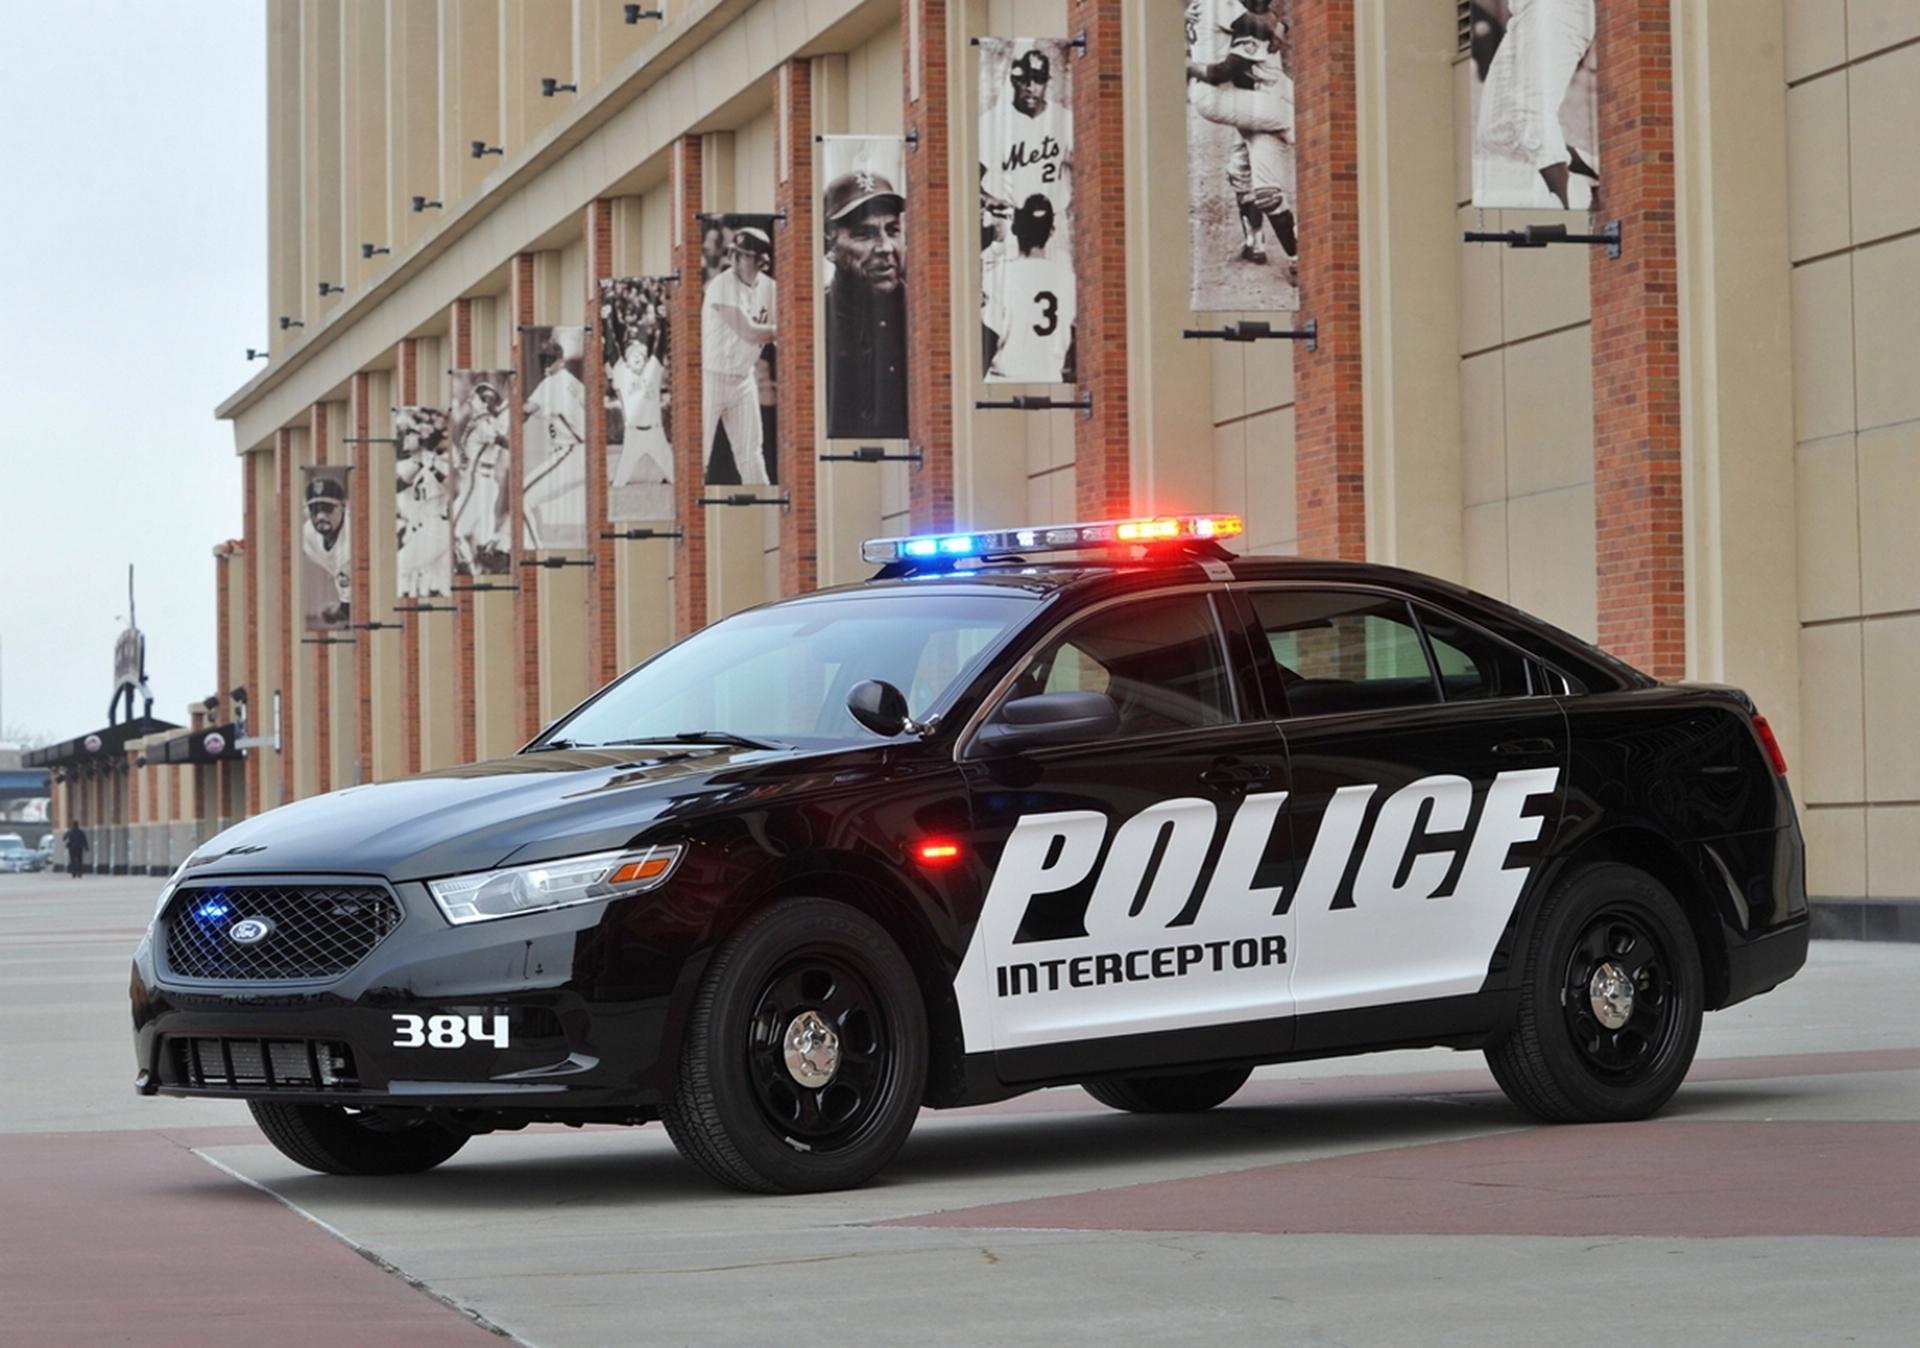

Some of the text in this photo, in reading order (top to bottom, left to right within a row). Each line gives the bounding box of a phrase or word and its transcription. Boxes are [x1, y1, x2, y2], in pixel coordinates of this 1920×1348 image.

[1001, 136, 1060, 171] Mets
[1033, 290, 1058, 337] 3
[980, 767, 1559, 945] POLICE
[996, 934, 1288, 998] INTERCEPTOR
[391, 1013, 510, 1049] 384
